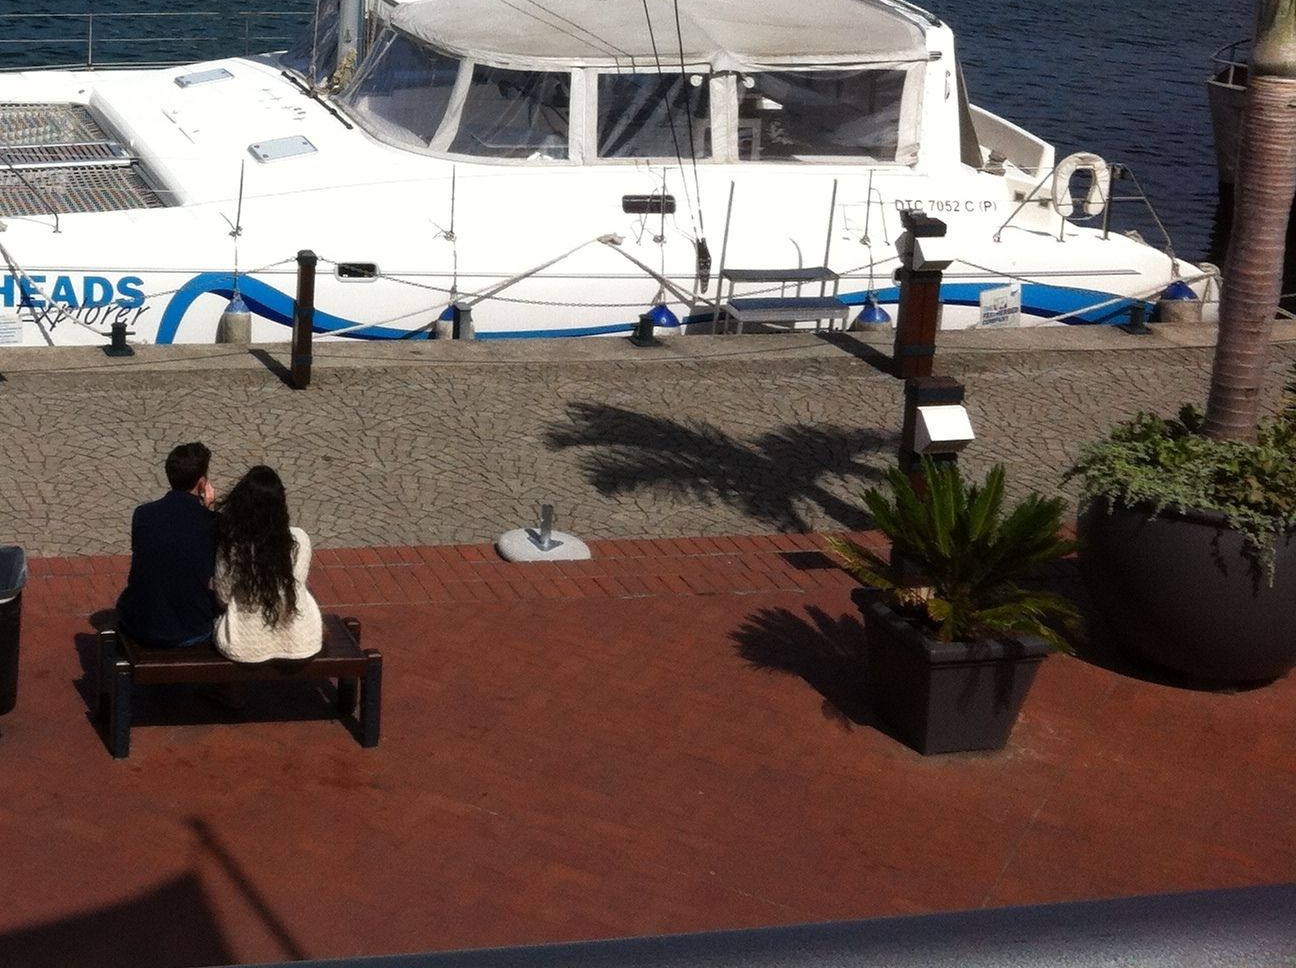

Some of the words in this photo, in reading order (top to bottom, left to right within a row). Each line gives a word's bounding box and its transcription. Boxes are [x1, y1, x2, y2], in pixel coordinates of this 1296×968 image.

[928, 200, 960, 212] 7052
[964, 200, 975, 212] C
[978, 200, 997, 213] (P)
[16, 296, 151, 332] Explorer
